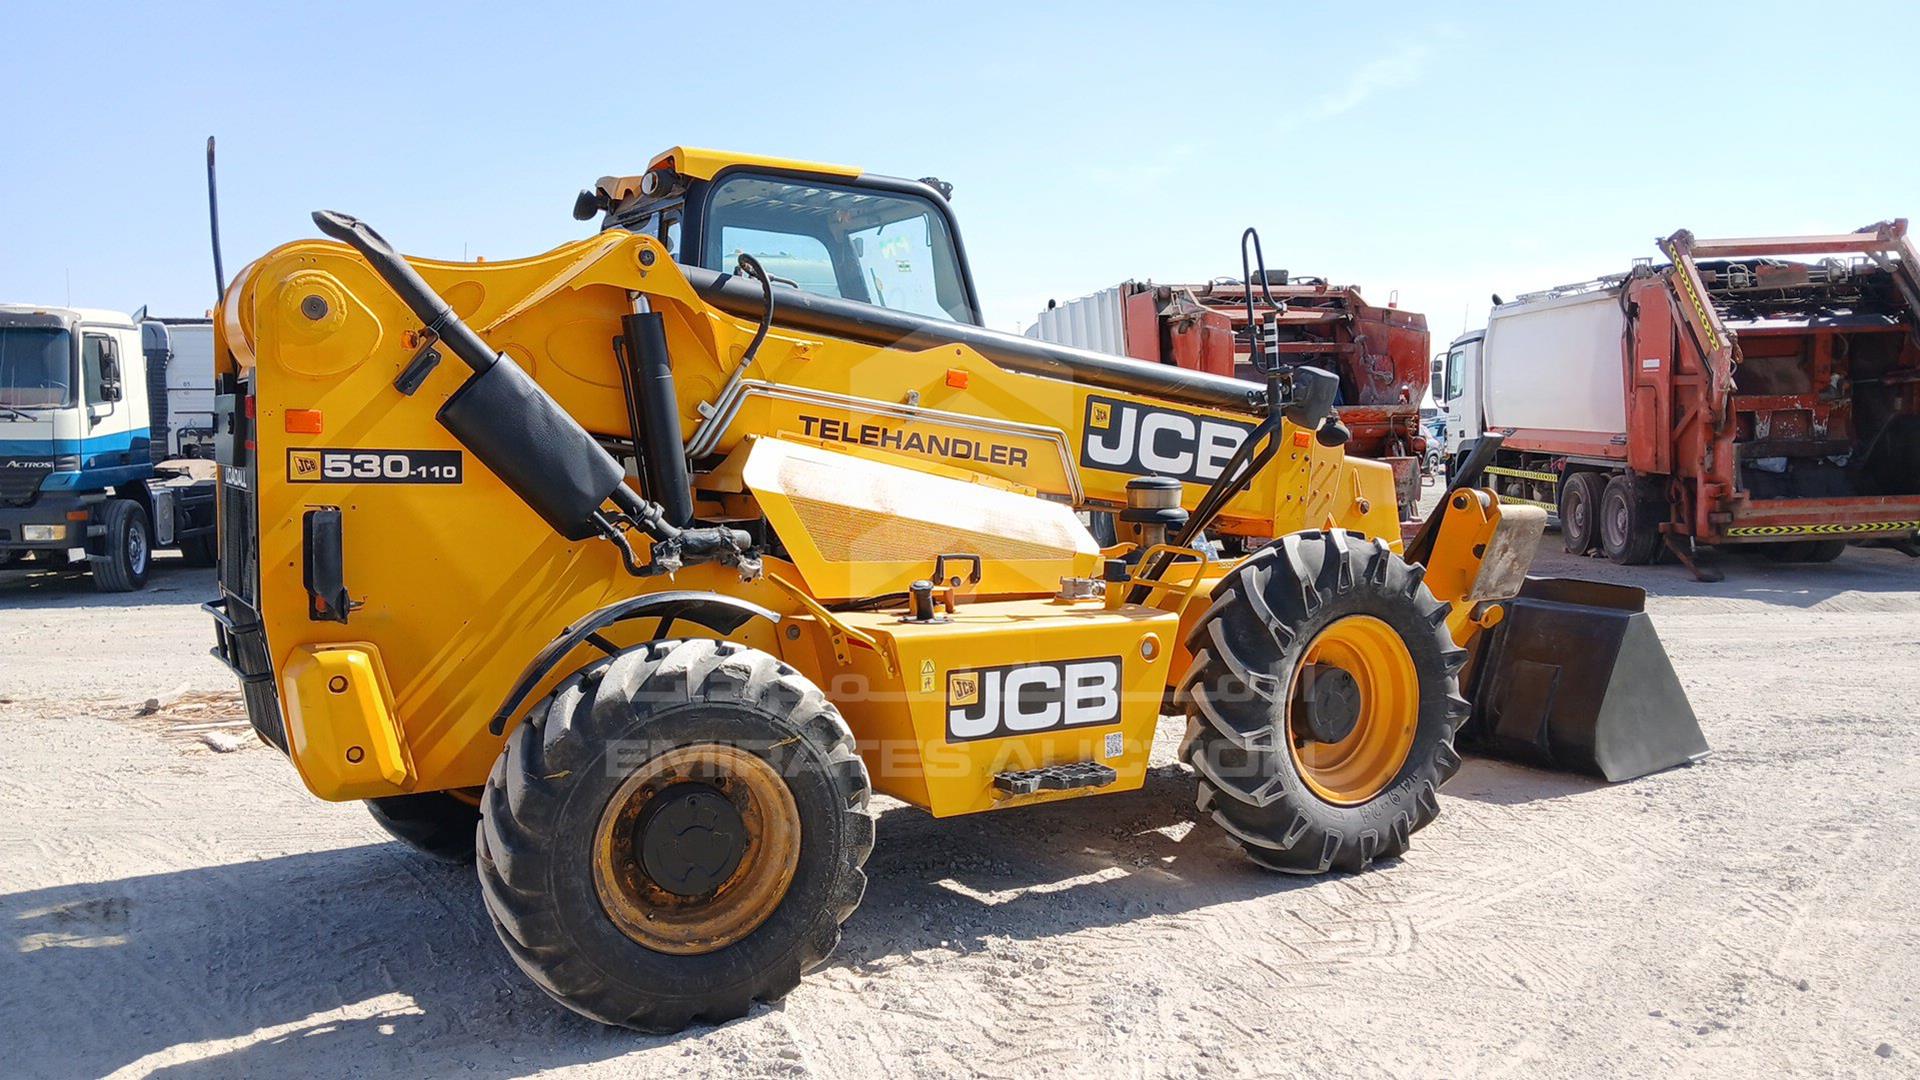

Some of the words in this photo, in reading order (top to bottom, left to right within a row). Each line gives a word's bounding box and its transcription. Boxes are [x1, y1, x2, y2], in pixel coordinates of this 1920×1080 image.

[798, 414, 1028, 468] TELEHANDLER
[1087, 406, 1250, 483] JCB
[298, 457, 316, 472] JCB
[323, 454, 457, 478] 530-110
[949, 660, 1119, 738] JCB
[955, 679, 976, 698] JCB
